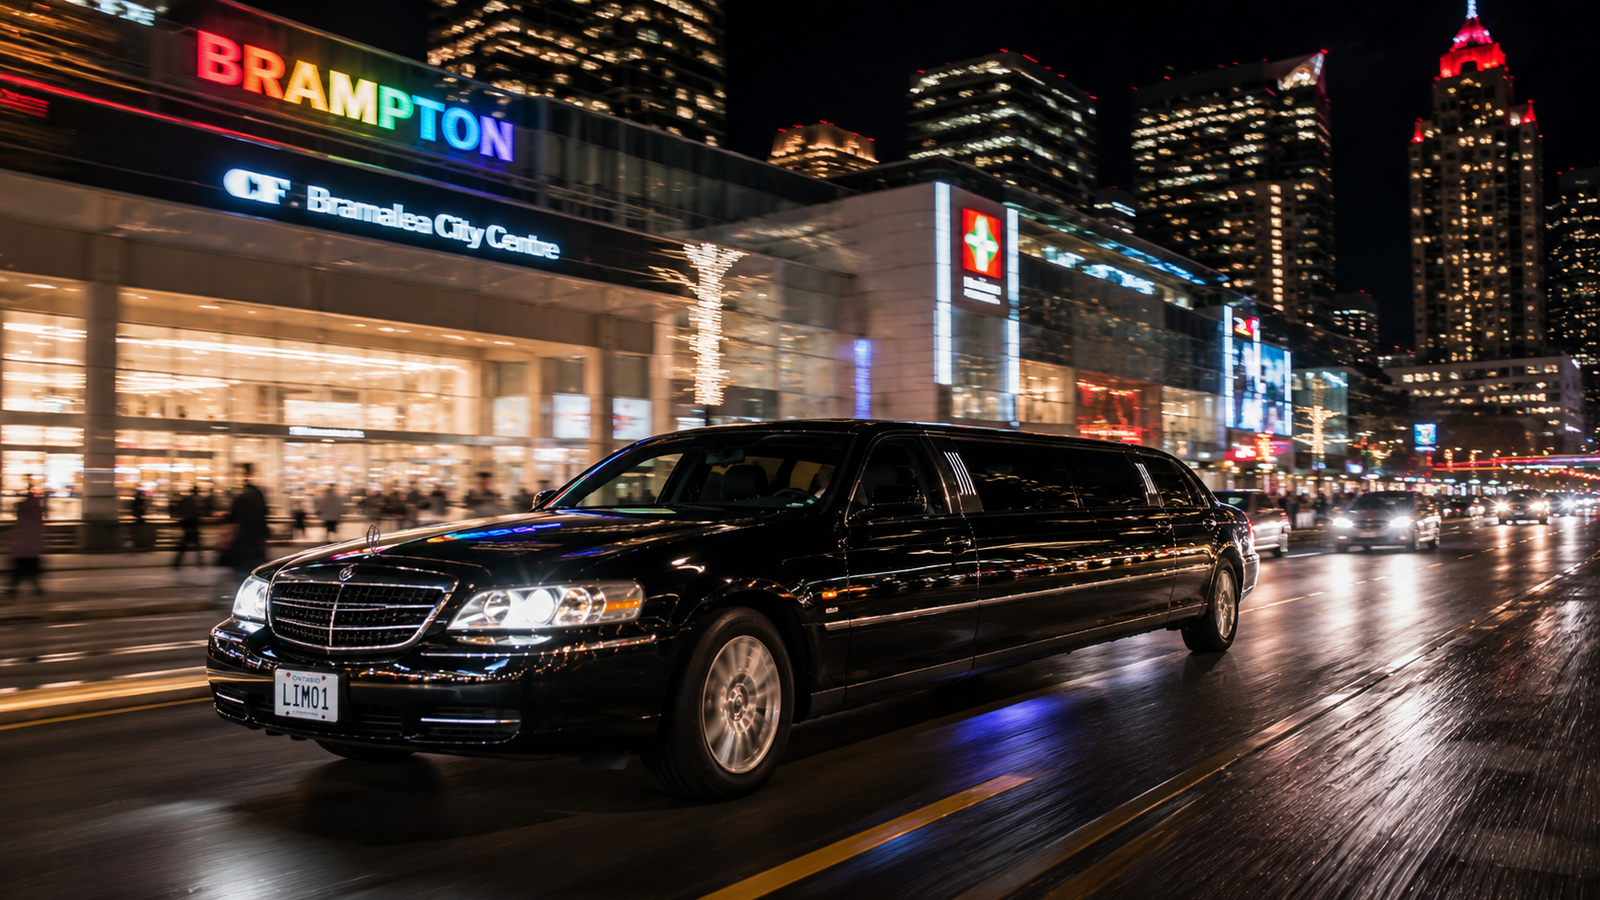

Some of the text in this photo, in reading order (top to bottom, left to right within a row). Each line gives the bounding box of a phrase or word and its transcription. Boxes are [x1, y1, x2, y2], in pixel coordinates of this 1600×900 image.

[197, 30, 513, 162] BRAMPTON
[223, 168, 561, 260] CF Bramalea City Centre
